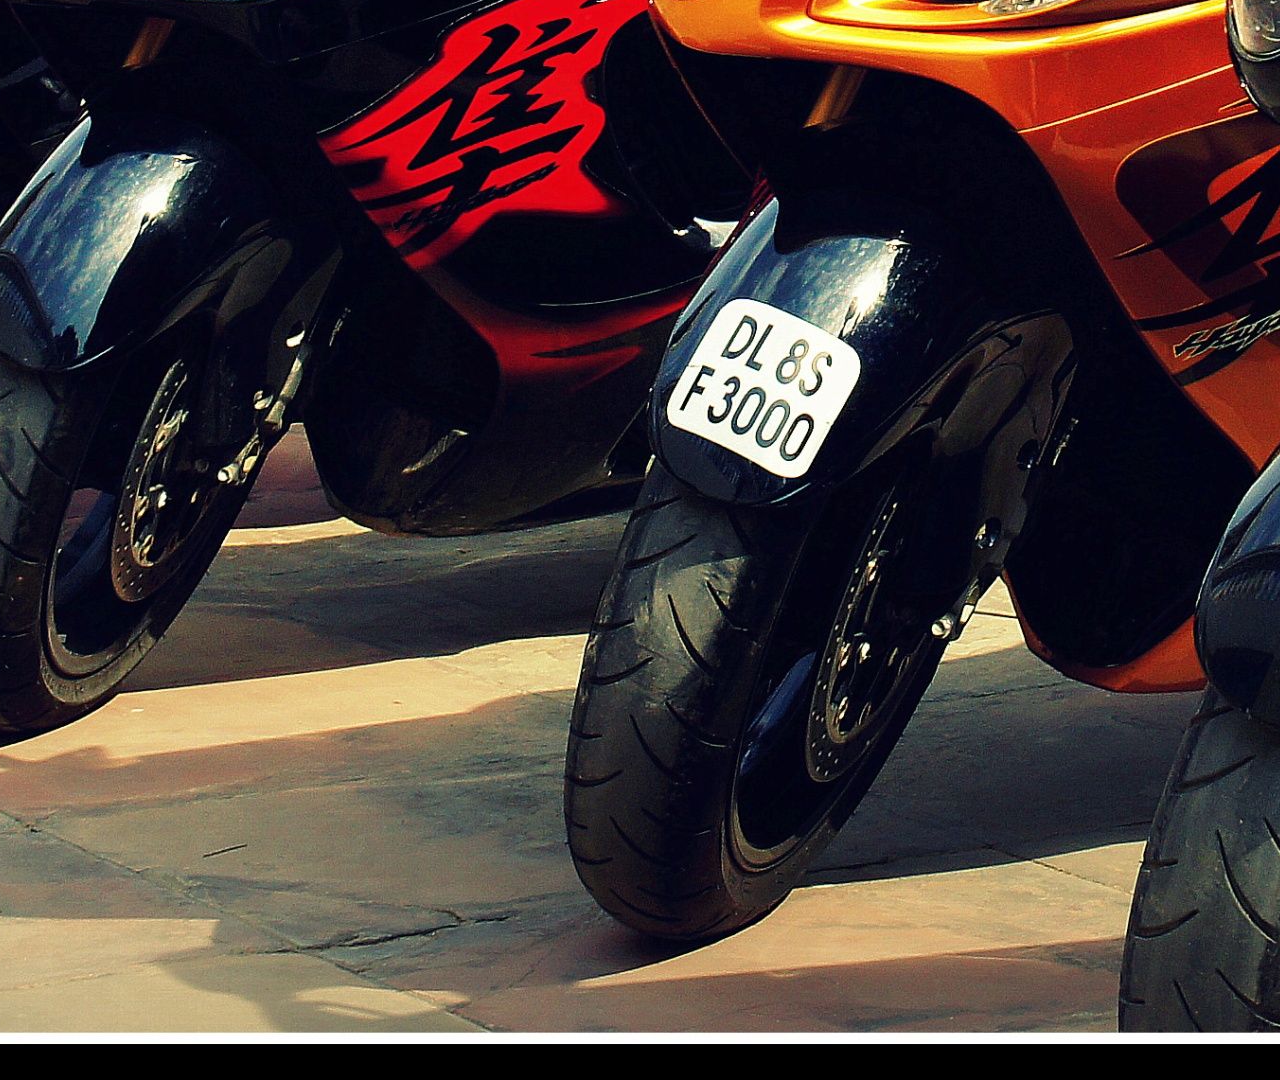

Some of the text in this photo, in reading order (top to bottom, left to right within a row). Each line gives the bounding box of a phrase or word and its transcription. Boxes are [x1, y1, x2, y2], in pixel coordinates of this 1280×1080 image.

[720, 315, 833, 397] DL 8S
[679, 365, 815, 462] F 3000
